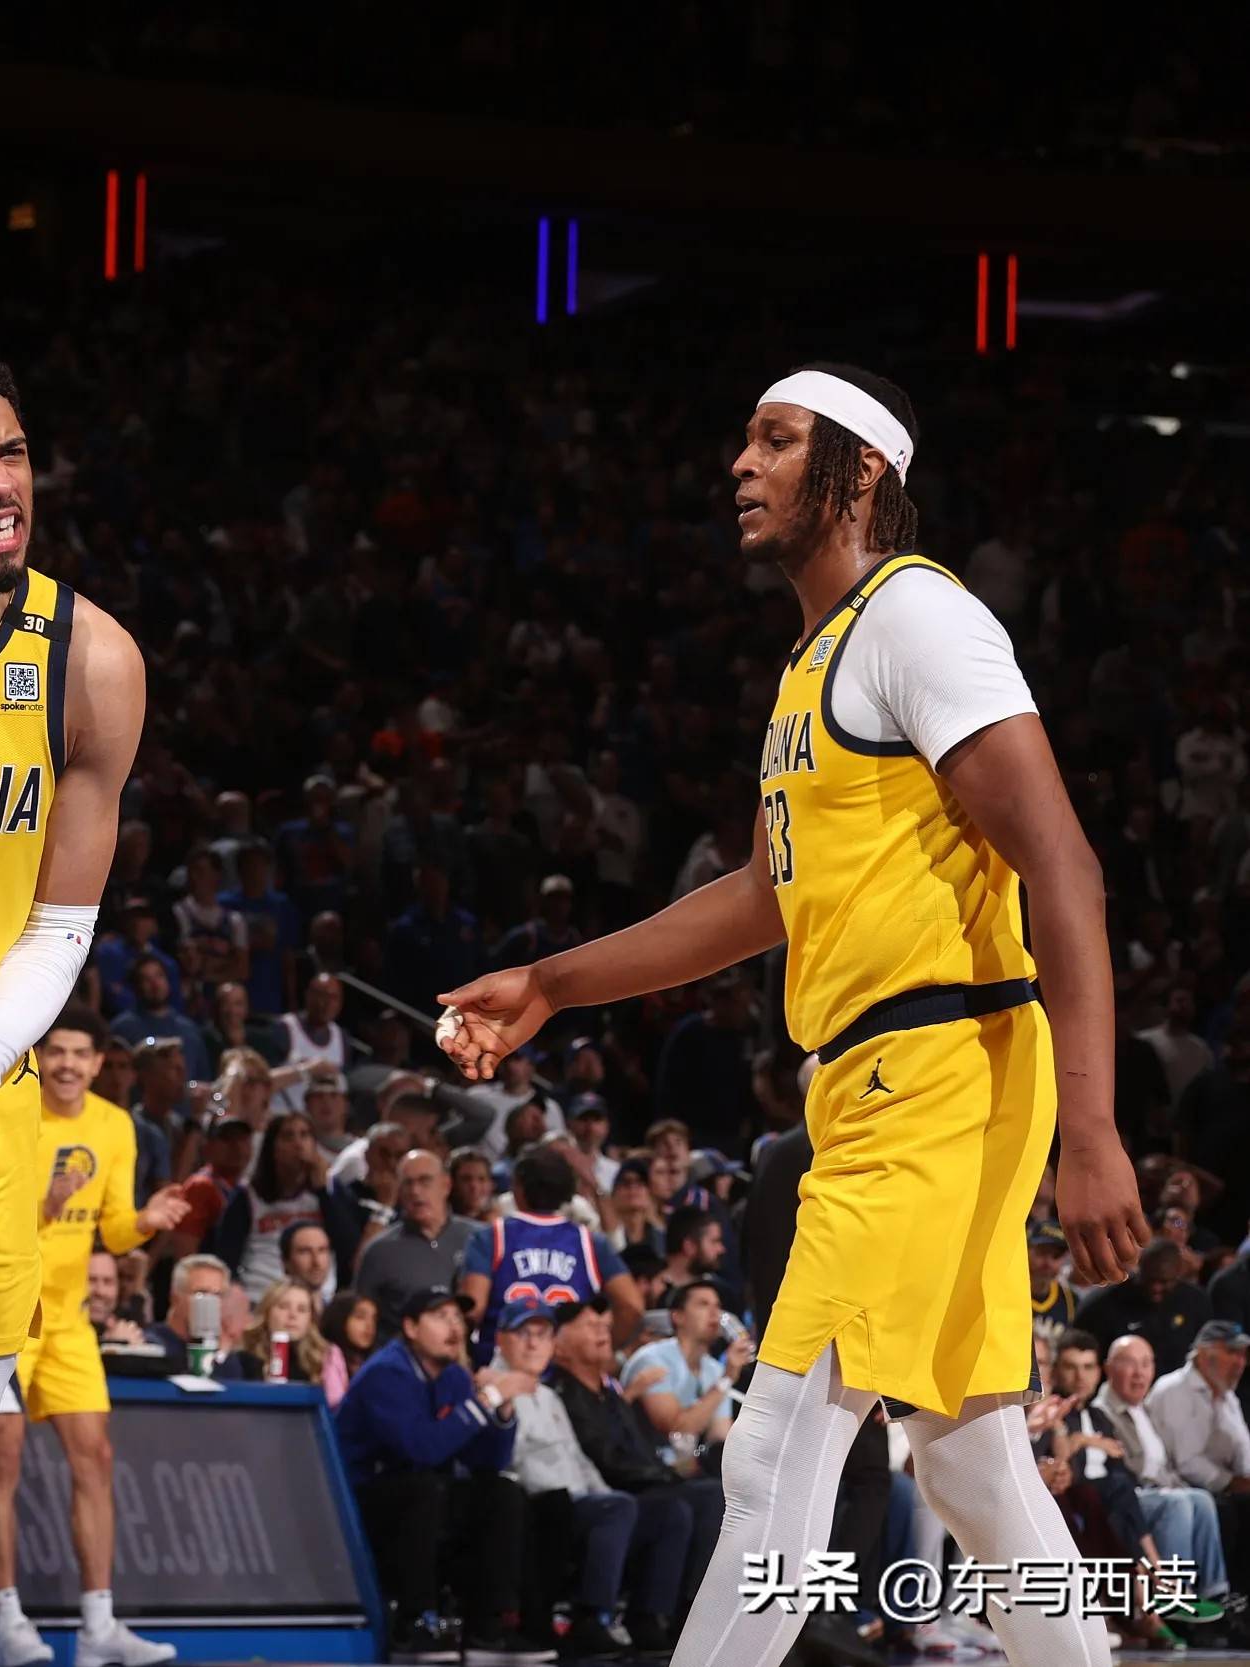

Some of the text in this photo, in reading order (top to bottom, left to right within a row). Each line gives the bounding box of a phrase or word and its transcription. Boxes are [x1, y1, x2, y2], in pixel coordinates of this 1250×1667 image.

[23, 615, 45, 633] 30
[0, 702, 44, 712] spokenote
[512, 1248, 577, 1282] EWING
